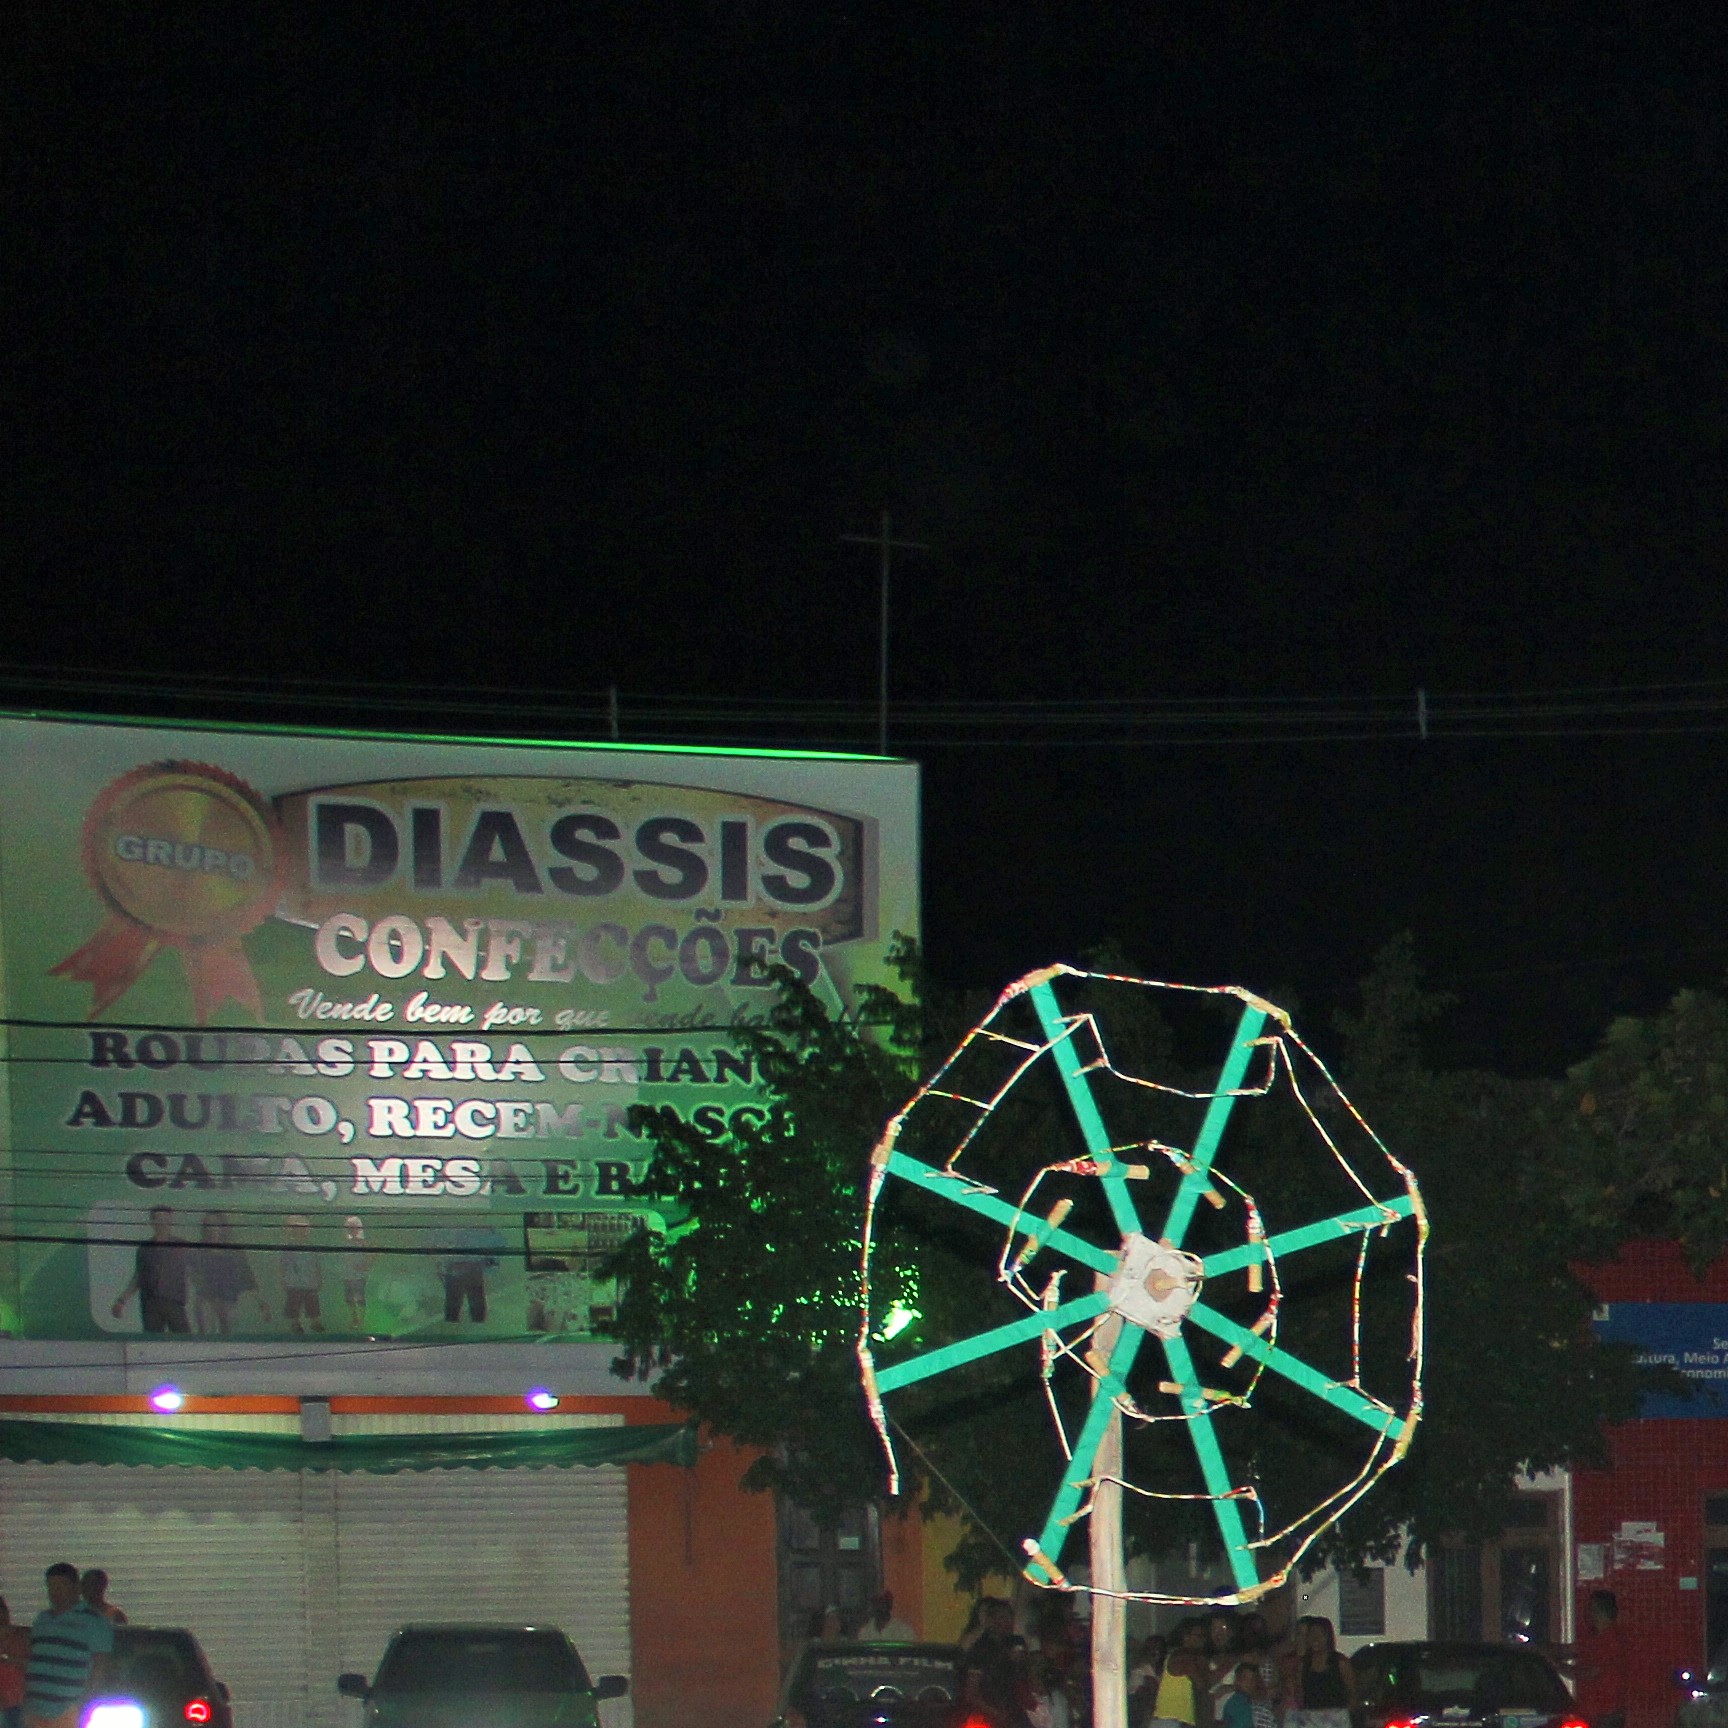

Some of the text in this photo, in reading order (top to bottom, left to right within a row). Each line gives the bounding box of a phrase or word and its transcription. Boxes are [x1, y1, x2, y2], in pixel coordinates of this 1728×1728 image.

[115, 835, 256, 881] GRUPO
[309, 797, 843, 909] DIASSIS
[314, 907, 822, 1002] CONFECÇÕES
[289, 987, 394, 1022] Vende
[404, 991, 474, 1025] bem
[483, 1001, 543, 1031] por
[88, 1030, 356, 1077] ROUPAS
[367, 1037, 545, 1082] PARA
[66, 1089, 356, 1144] ADULTO,
[125, 1152, 339, 1201] CAMA,
[351, 1157, 528, 1197] MESA
[542, 1158, 582, 1197] E
[1684, 1353, 1719, 1366] Meio
